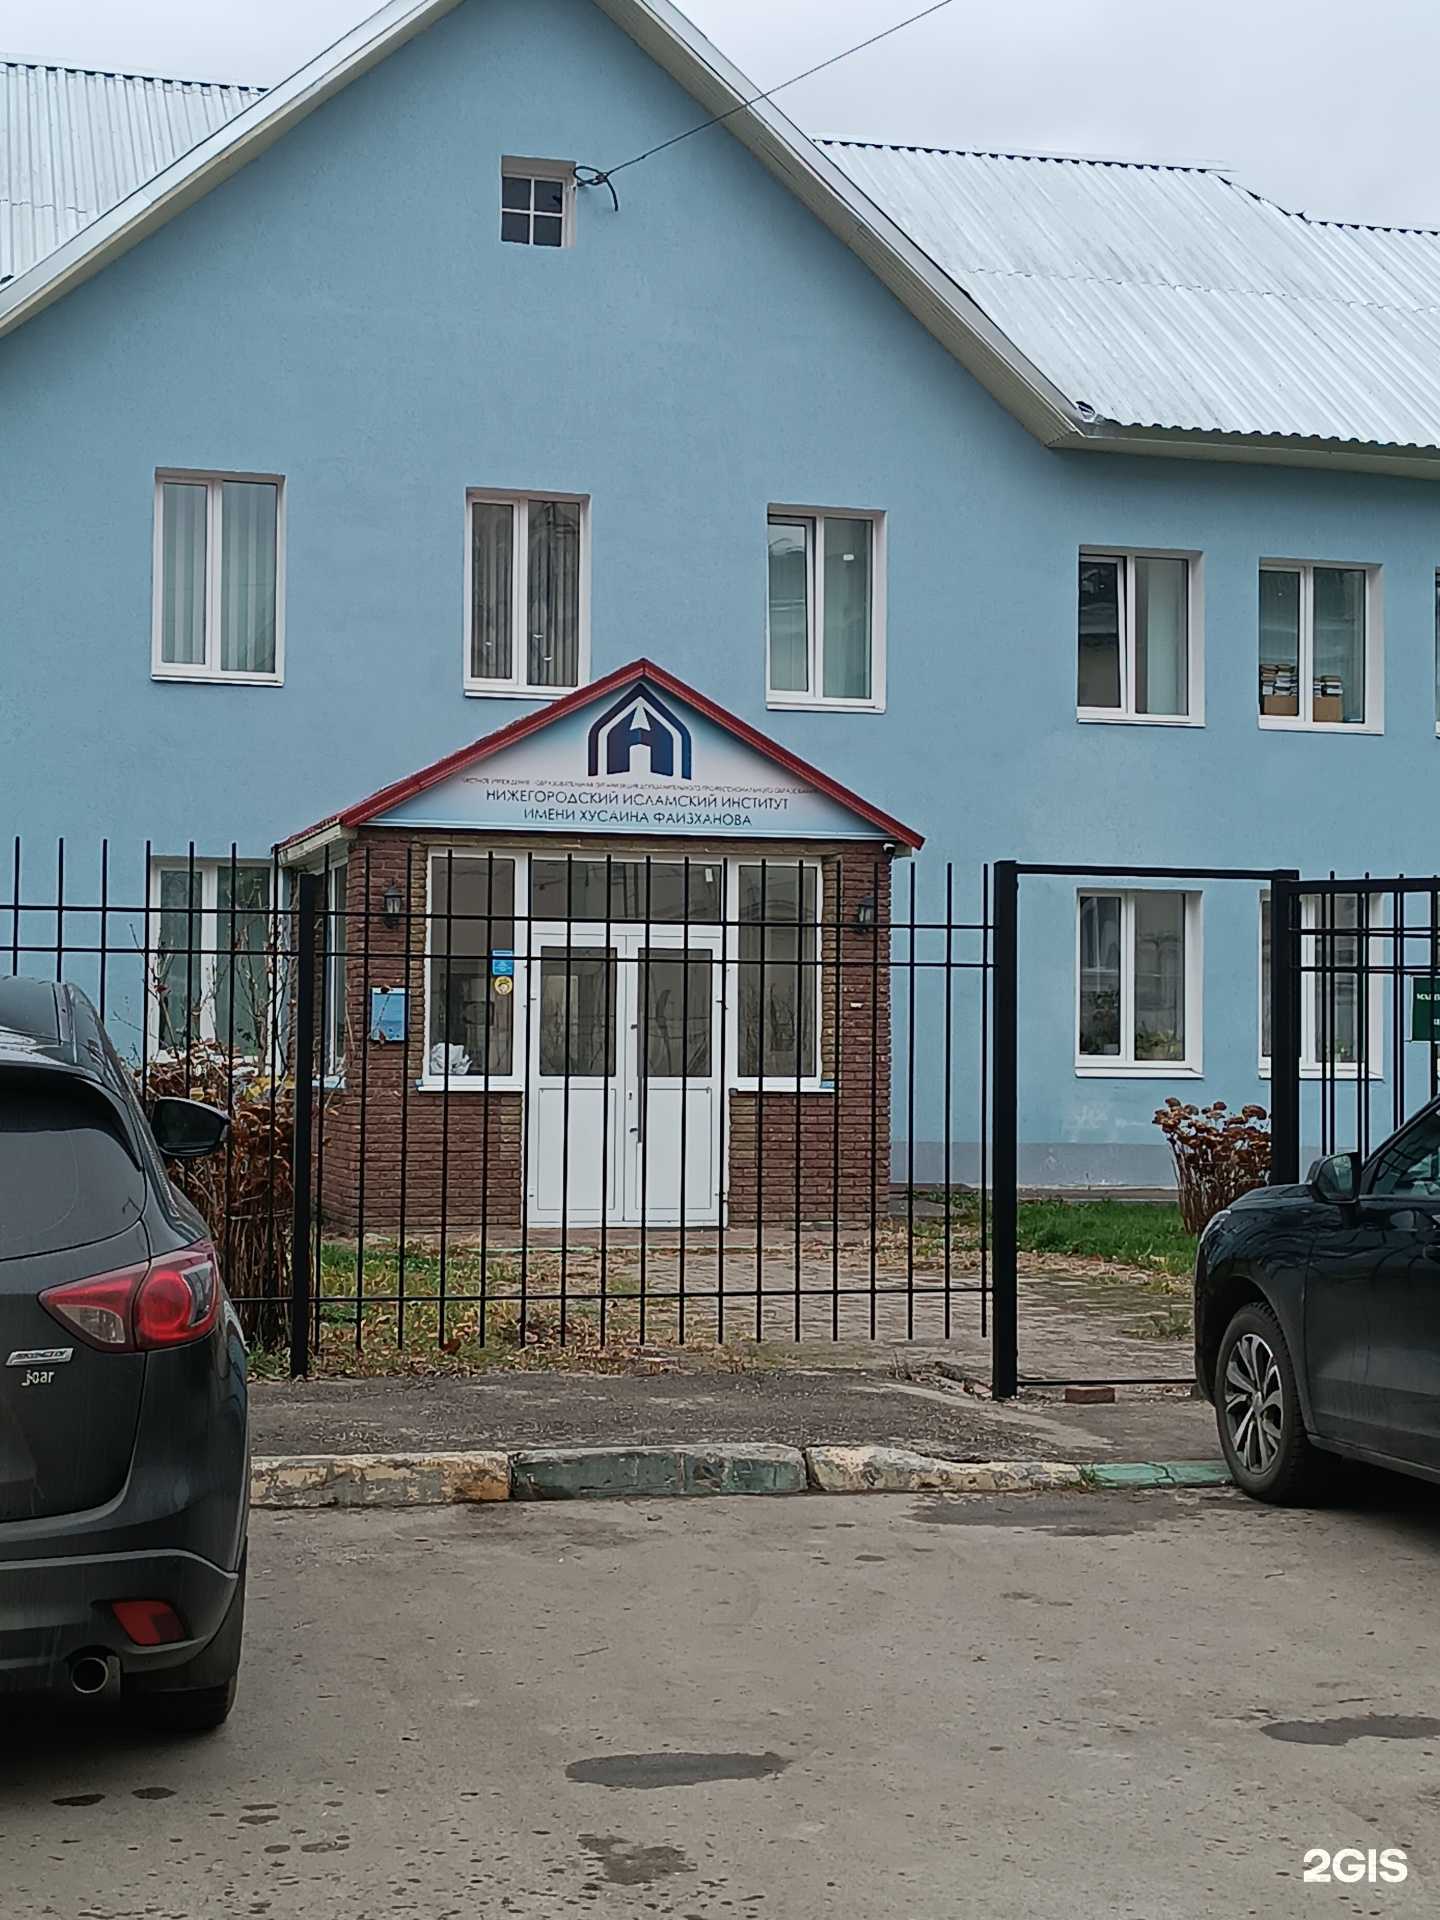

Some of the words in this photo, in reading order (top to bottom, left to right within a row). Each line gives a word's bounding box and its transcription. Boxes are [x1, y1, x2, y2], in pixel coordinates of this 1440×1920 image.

[486, 789, 619, 806] НИЖЕГОРОДСКИЙ
[623, 793, 718, 808] ИСЛАМСКИЙ
[721, 796, 789, 810] ИНСТИТУТ
[524, 808, 576, 821] ИМЕНИ
